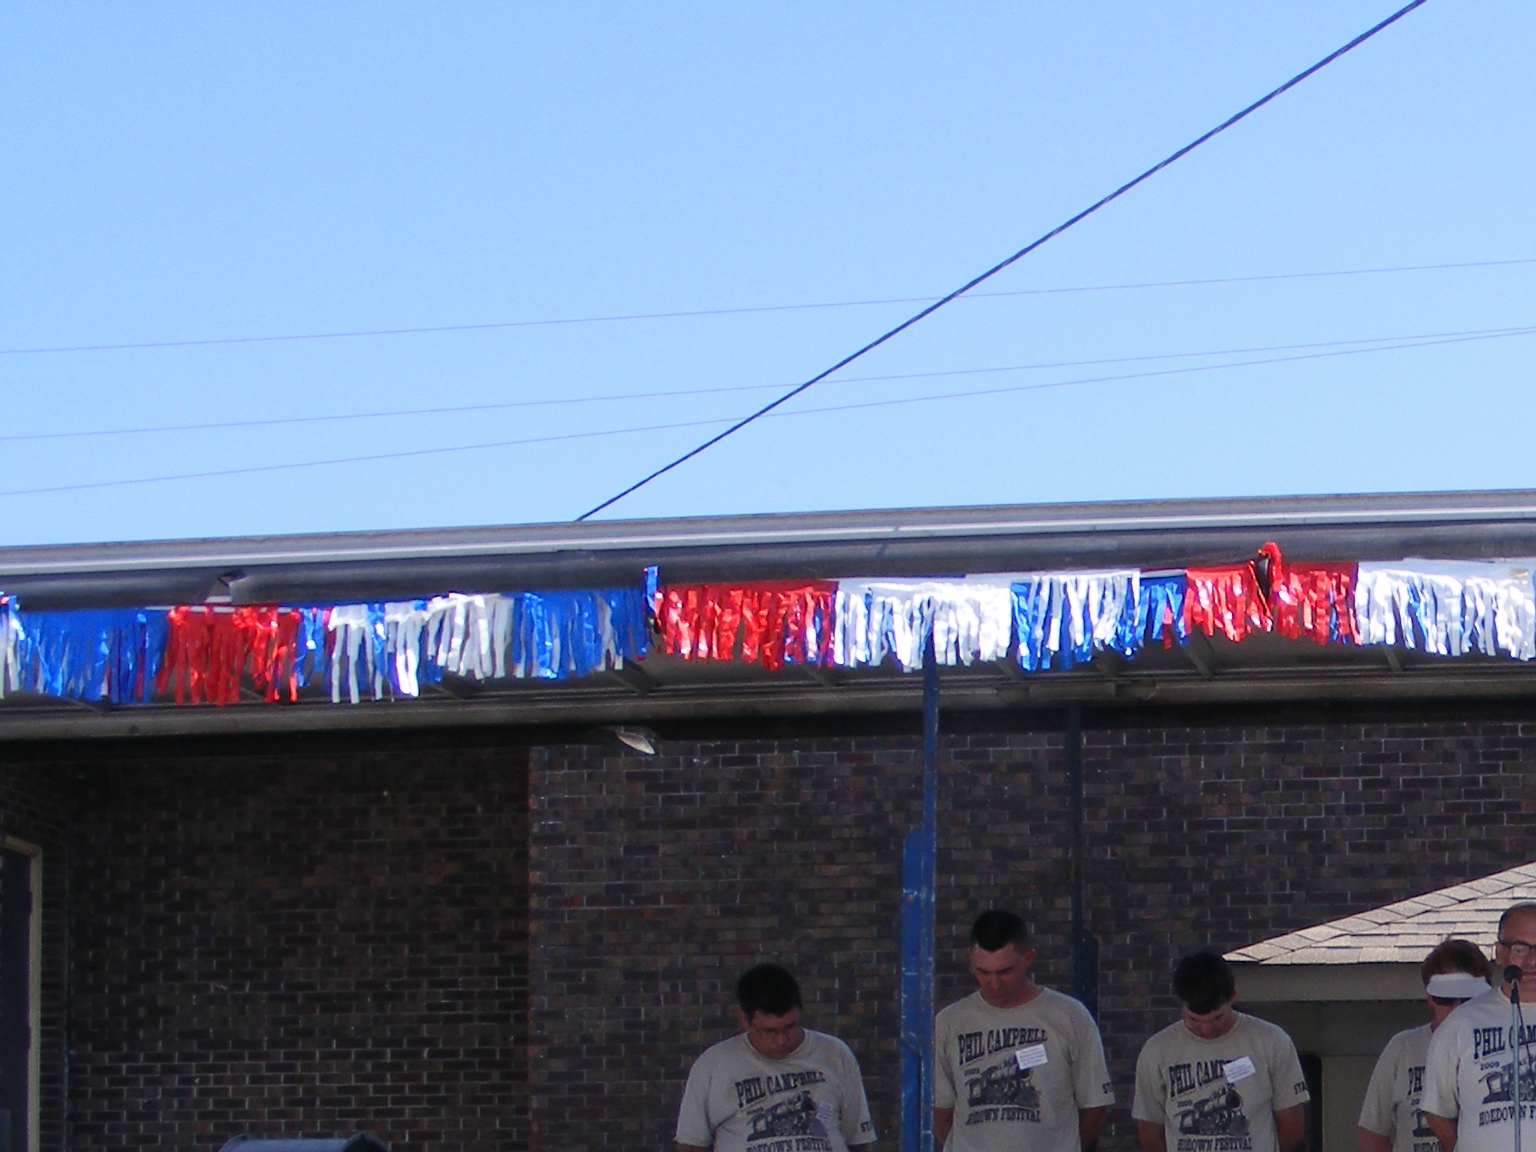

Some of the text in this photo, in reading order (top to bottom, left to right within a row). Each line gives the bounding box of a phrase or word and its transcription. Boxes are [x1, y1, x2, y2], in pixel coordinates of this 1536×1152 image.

[957, 1031, 985, 1065] PHIL
[987, 1027, 1048, 1054] CAMPBELL
[1473, 1027, 1506, 1059] PHIL
[734, 1070, 826, 1108] PHIL CAMPBELL
[1168, 1061, 1196, 1097] PHIL
